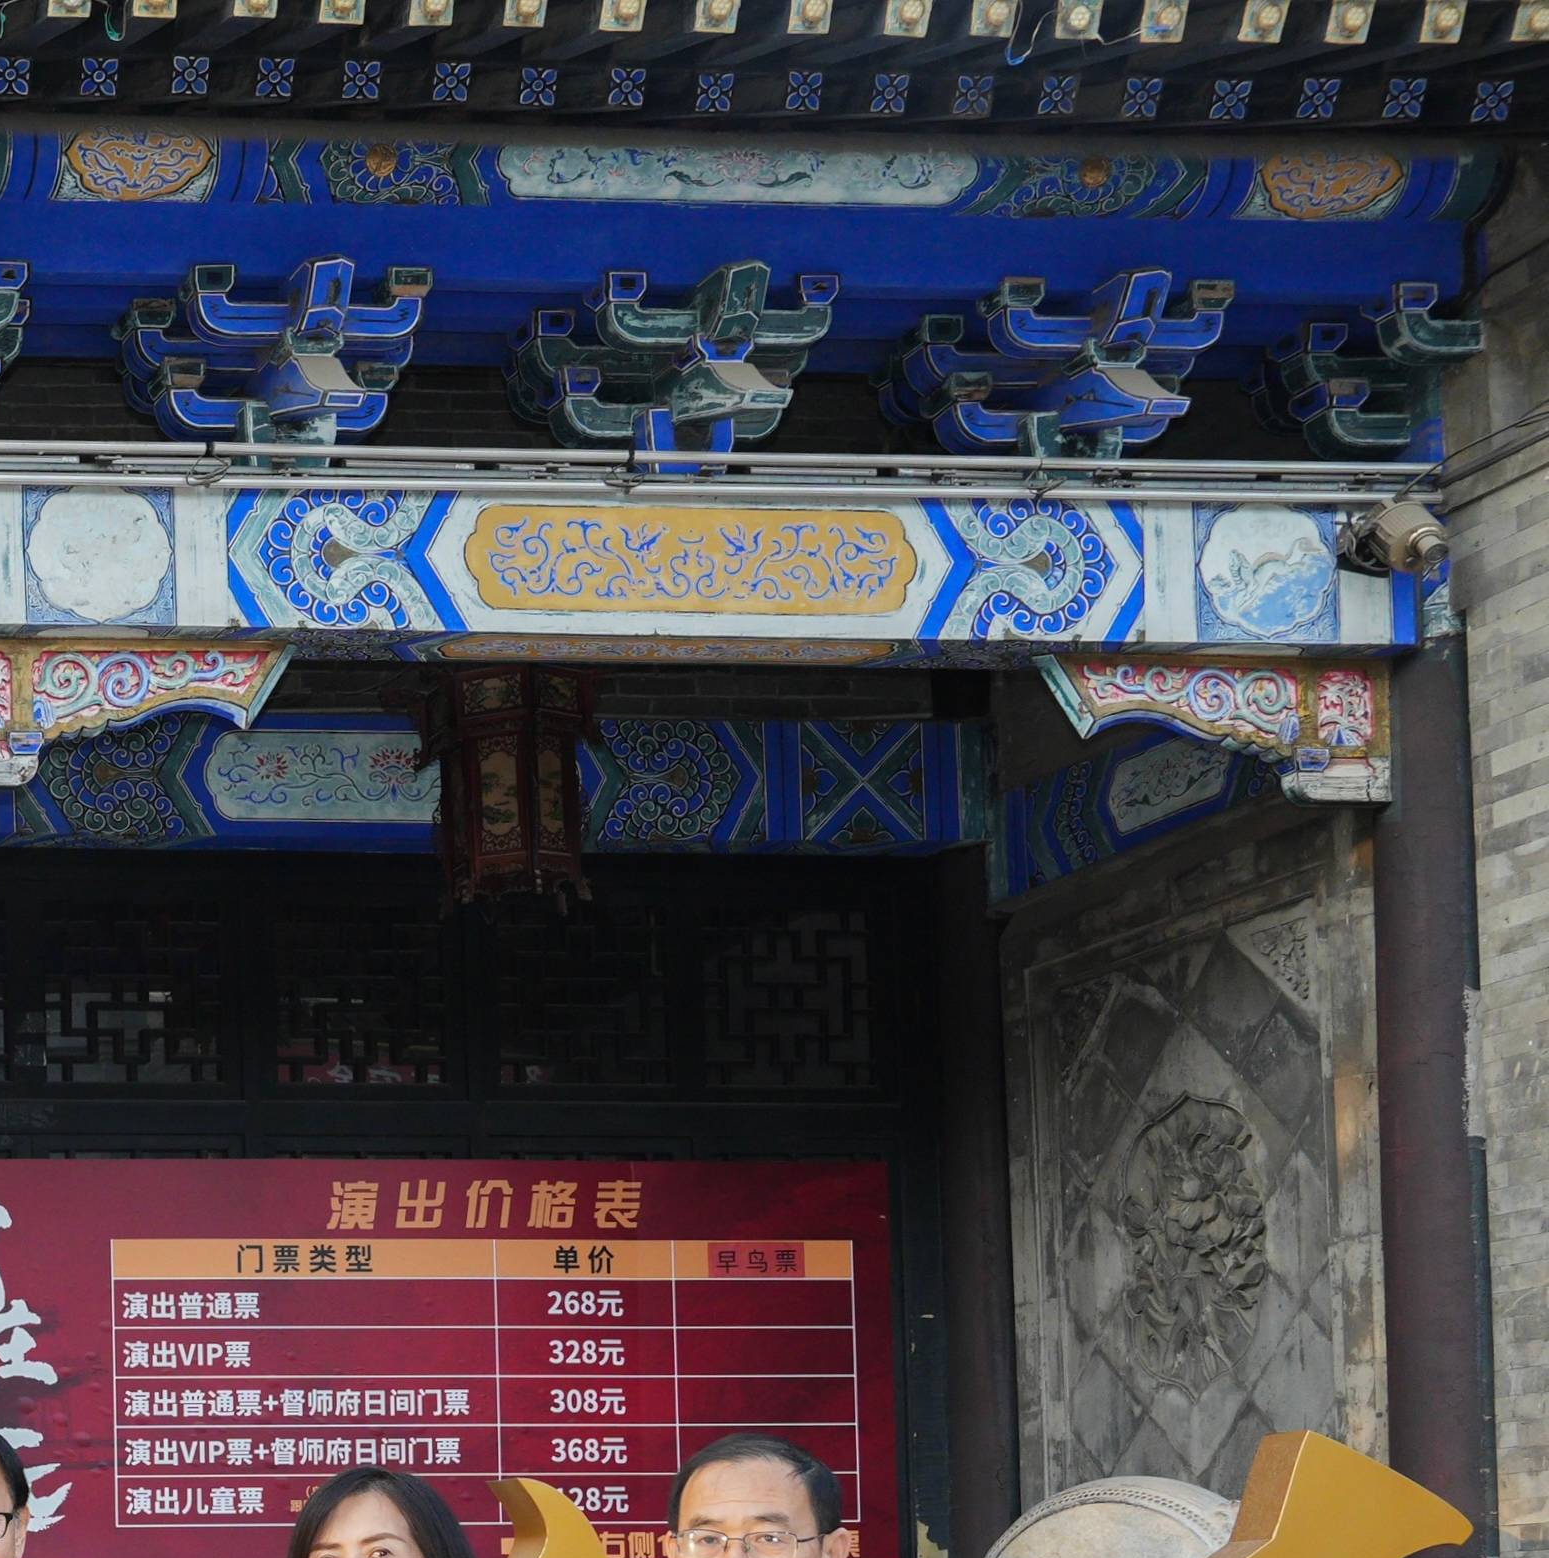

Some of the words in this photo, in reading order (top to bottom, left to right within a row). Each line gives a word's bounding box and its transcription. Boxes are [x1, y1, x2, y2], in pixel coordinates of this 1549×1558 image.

[327, 1178, 643, 1231] 演出价格表
[236, 1244, 373, 1275] 门票类型
[553, 1244, 614, 1275] 单价
[715, 1249, 799, 1275] 早鸟票
[122, 1291, 261, 1320] 演出普通票
[547, 1289, 624, 1318] 268元
[123, 1340, 252, 1369] 演出VIP票
[548, 1339, 625, 1368] 328元
[124, 1388, 471, 1418] 演出普通票+督师府日间门票
[549, 1387, 627, 1416] 308元
[125, 1437, 462, 1467] 演出VIP票+督师府日间门票
[551, 1437, 629, 1465] 368元
[126, 1486, 265, 1516] 演出儿童票
